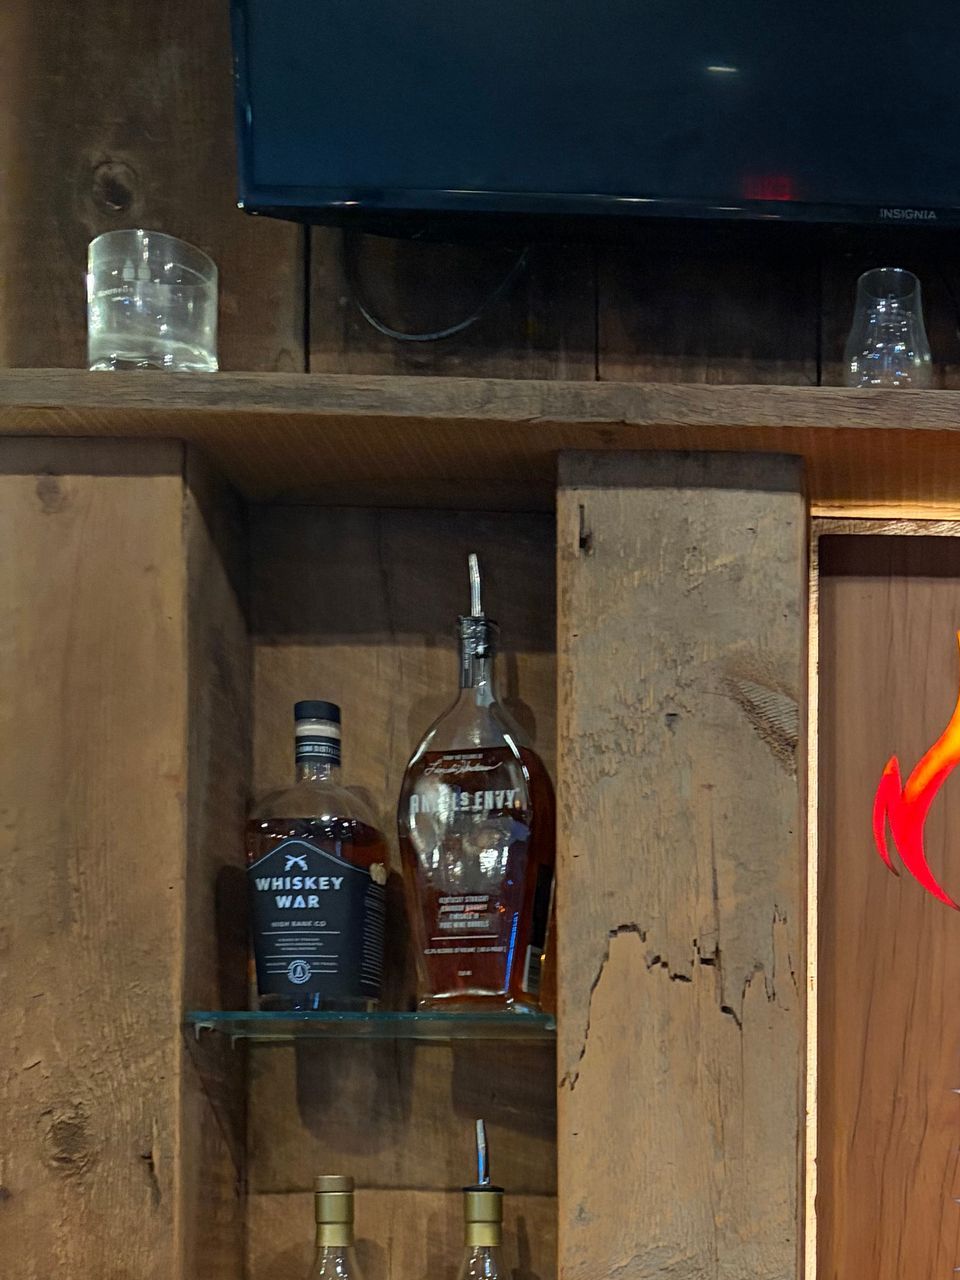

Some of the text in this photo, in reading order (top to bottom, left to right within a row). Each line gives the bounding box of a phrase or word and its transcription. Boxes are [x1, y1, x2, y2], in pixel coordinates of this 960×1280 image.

[879, 208, 938, 220] INSIGNIA
[255, 876, 344, 891] WHISKEY
[275, 895, 320, 909] WAR
